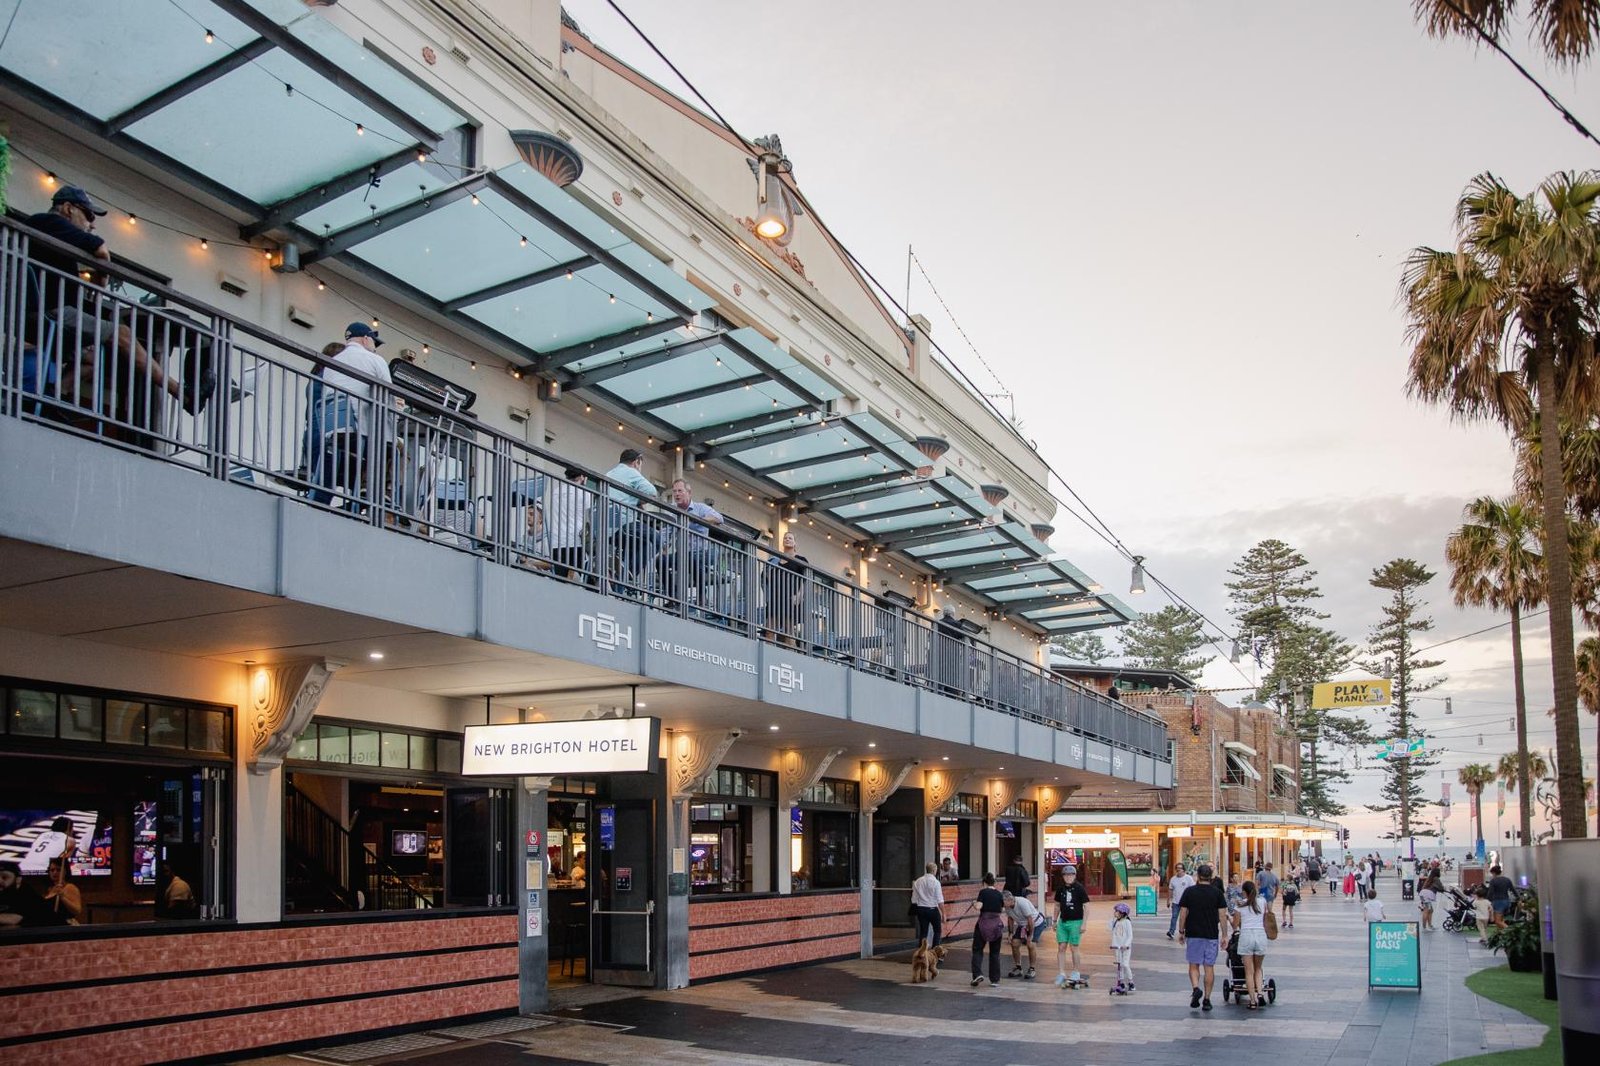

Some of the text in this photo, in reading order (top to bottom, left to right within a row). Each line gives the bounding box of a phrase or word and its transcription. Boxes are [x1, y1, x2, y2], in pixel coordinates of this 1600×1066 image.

[647, 639, 759, 675] NEW BRIGHTON HOTEL
[1334, 684, 1369, 696] PLAY
[1333, 694, 1368, 704] MANLY
[474, 739, 638, 756] NEW BRIGHTON HOTEL
[34, 841, 49, 853] 5
[1375, 930, 1408, 941] GAMES
[1375, 940, 1401, 950] OASIS
